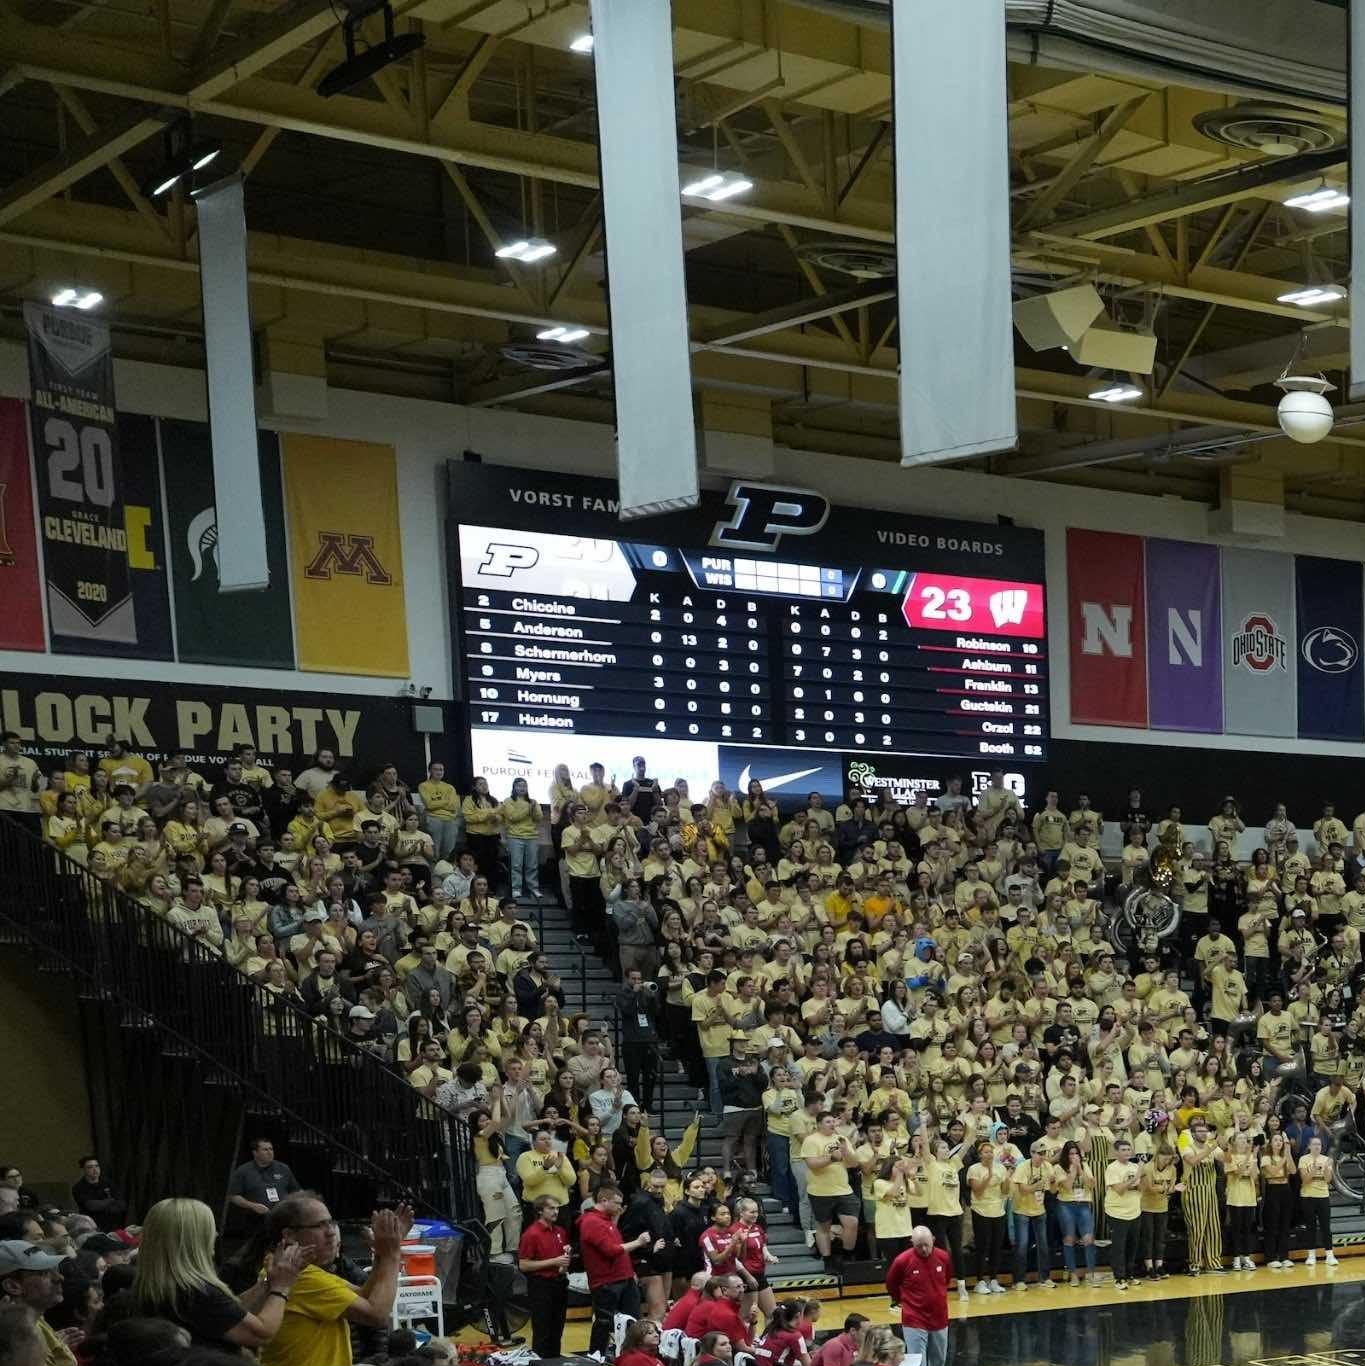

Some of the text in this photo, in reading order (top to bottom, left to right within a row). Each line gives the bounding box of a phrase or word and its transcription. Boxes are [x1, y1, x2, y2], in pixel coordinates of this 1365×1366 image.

[44, 417, 115, 507] 20
[509, 488, 575, 508] VORST
[44, 516, 127, 552] CLEVELAND
[876, 530, 1004, 556] VIDEO BOARDS
[652, 550, 668, 567] 0
[702, 556, 732, 571] PUR
[76, 581, 107, 602] 2020
[706, 573, 733, 586] WIS
[477, 594, 758, 629] 2 Chicoine 2 0 4 0
[650, 593, 757, 612] K A D B
[790, 605, 887, 623] K A D B
[920, 586, 973, 621] 23
[479, 618, 758, 650] 5 Anderson 0 13 2 0
[790, 622, 801, 633] 0
[820, 625, 831, 636] 0
[878, 630, 888, 640] 2
[956, 637, 1011, 652] Robinson
[1081, 602, 1133, 658] N
[1168, 608, 1202, 667] N
[514, 644, 616, 664] Schermerhorn
[652, 654, 663, 666] 0
[685, 657, 696, 668] 0
[718, 660, 729, 671] 3
[749, 662, 759, 673] 0
[821, 646, 831, 657] 7
[852, 649, 862, 660] 3
[879, 651, 889, 662] 0
[962, 659, 1012, 673] Ashburn
[1025, 664, 1037, 674] 11
[481, 665, 761, 694] 9 Myers 3 0 0
[793, 665, 1039, 695] 7 0 2 0 Franklin 13
[480, 688, 762, 716] 10 Hornung 0 0
[793, 687, 804, 698] 0
[825, 689, 832, 700] 1
[881, 693, 890, 704] 0
[1025, 704, 1040, 715] 21
[0, 689, 361, 757] LOCK PARTY
[481, 711, 762, 738] 17 Hudson 4 0 2 2
[794, 708, 1042, 736] 2 0 3 0 Orzol 22
[795, 729, 806, 741] 3
[825, 731, 835, 743] 0
[882, 735, 892, 746] 2
[979, 742, 1014, 755] Booth
[482, 766, 533, 778] PURDUE
[864, 775, 940, 790] WESTMINSTER
